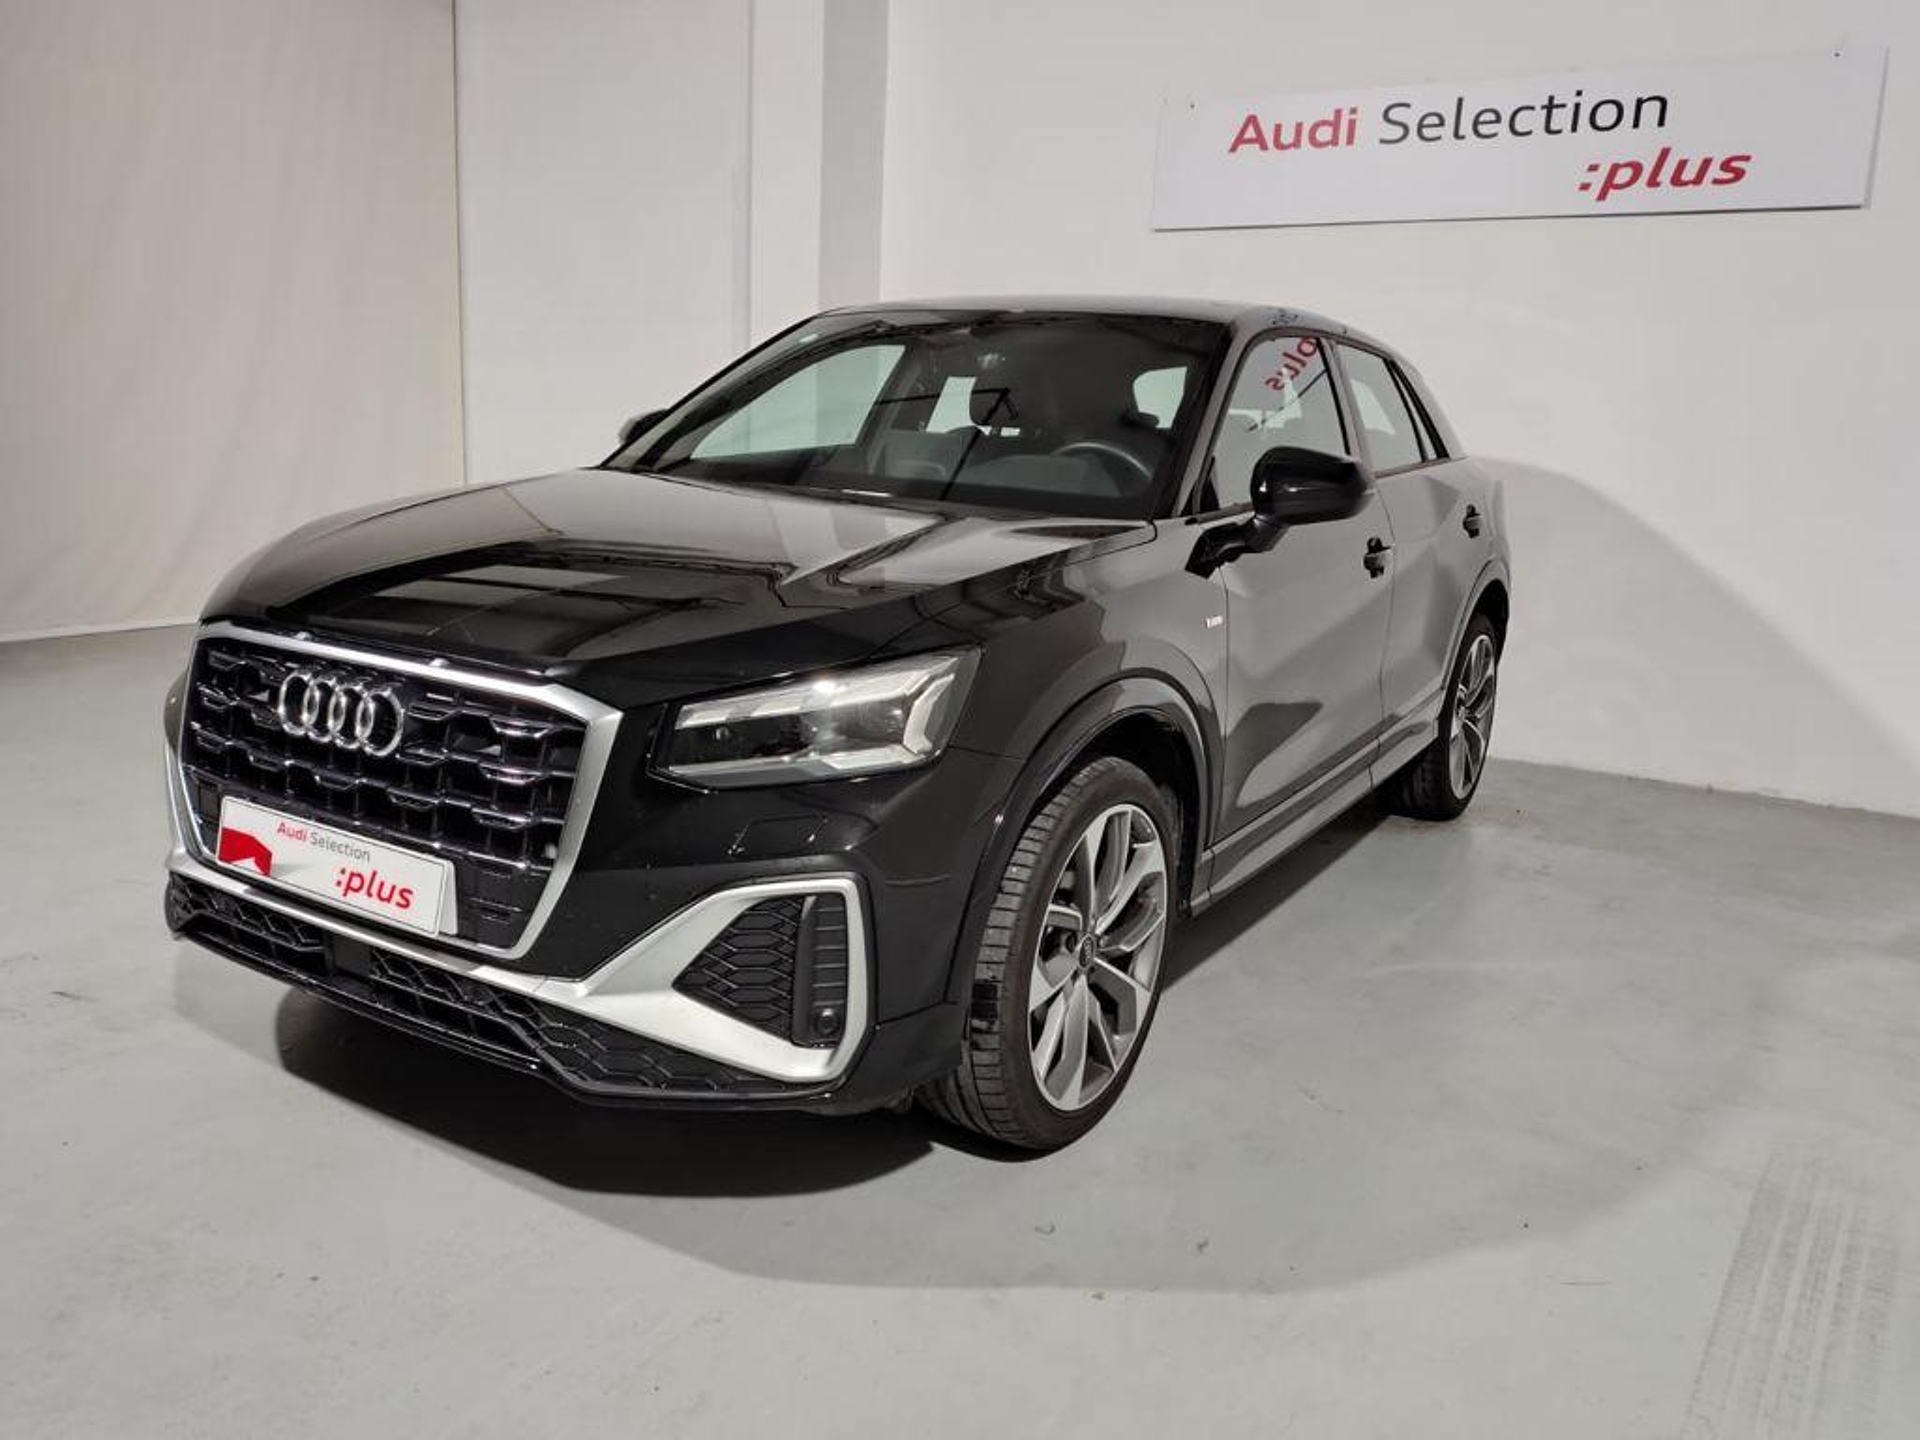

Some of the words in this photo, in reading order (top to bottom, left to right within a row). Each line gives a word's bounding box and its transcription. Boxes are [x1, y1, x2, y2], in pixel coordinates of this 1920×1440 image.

[1228, 107, 1360, 153] Audi
[1378, 89, 1670, 146] Selection
[1578, 147, 1753, 201] :plus
[277, 821, 308, 842] Audi
[310, 832, 370, 862] Selection
[335, 867, 414, 910] :plus
